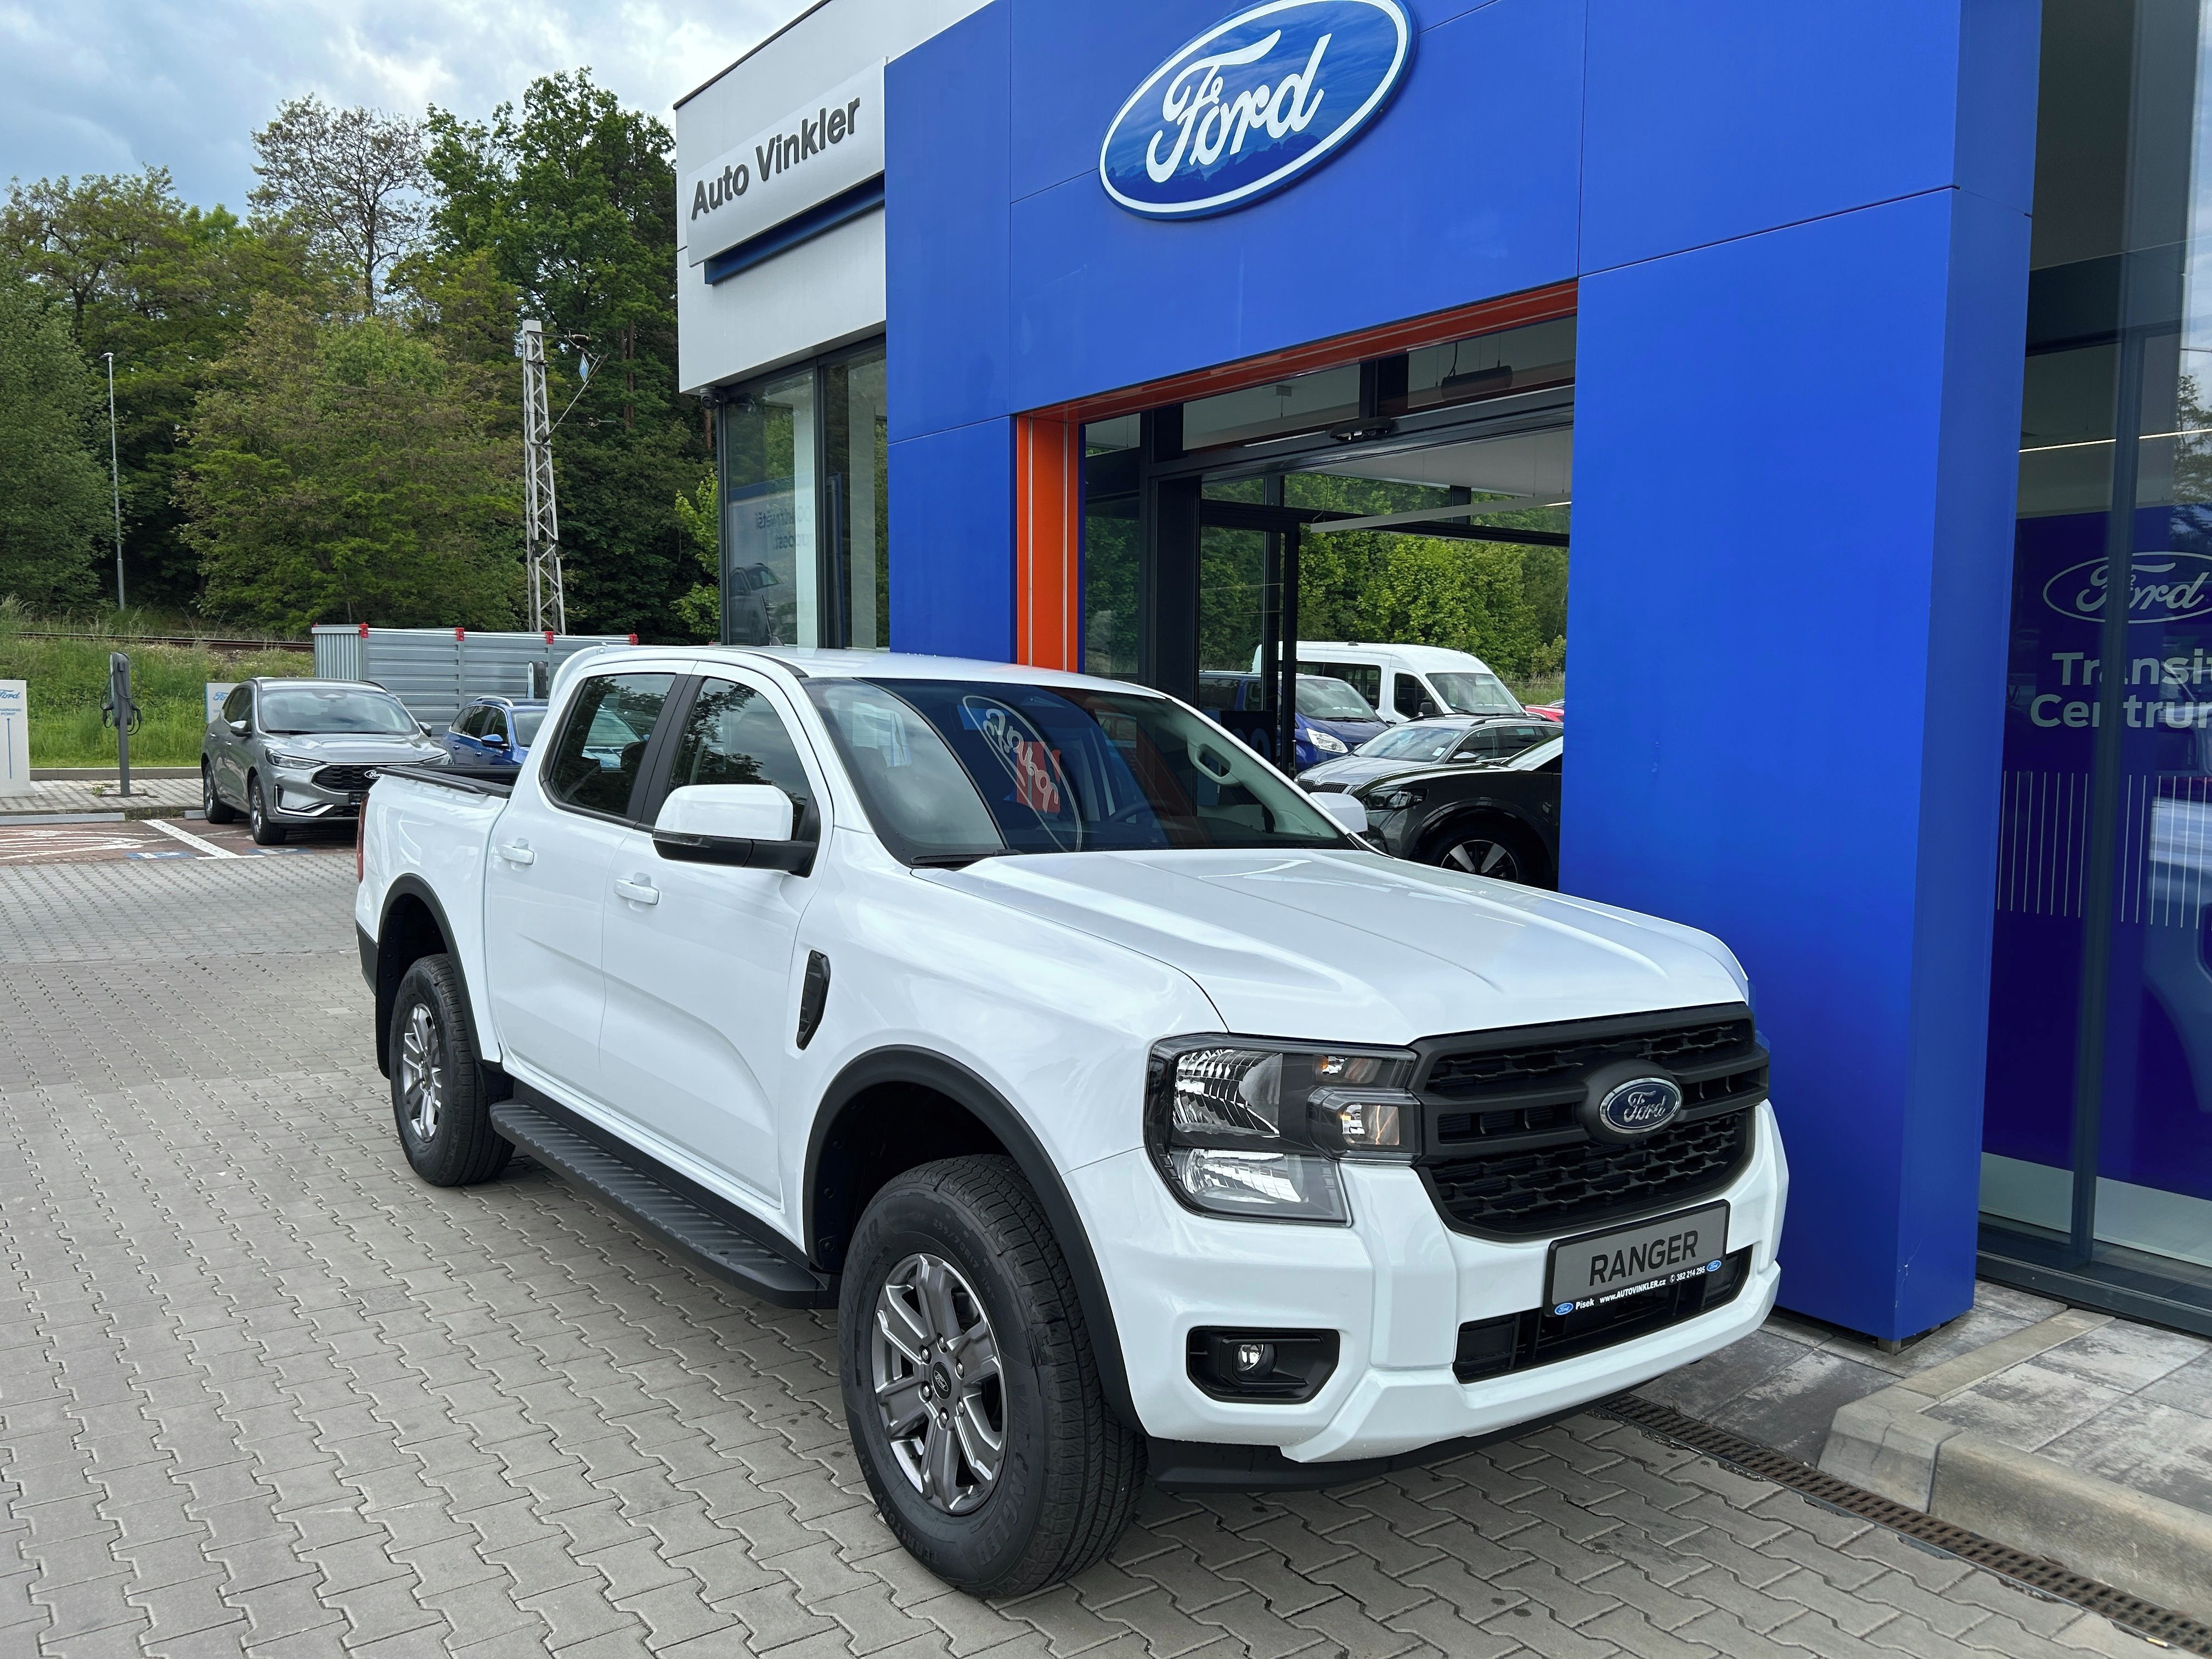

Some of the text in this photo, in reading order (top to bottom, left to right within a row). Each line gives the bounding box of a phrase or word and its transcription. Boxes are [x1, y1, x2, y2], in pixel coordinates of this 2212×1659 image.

[1146, 29, 1332, 183] Ford
[691, 97, 860, 221] Auto Vinkler
[1623, 1090, 1667, 1123] Ford
[1589, 1230, 1699, 1286] RANGER
[1599, 1279, 1667, 1304] www.AUTOVINKLER.cz
[1676, 1272, 1686, 1282] 382
[1686, 1268, 1696, 1278] 214
[935, 1373, 946, 1389] Ford
[874, 1493, 940, 1565] TERRITORY
